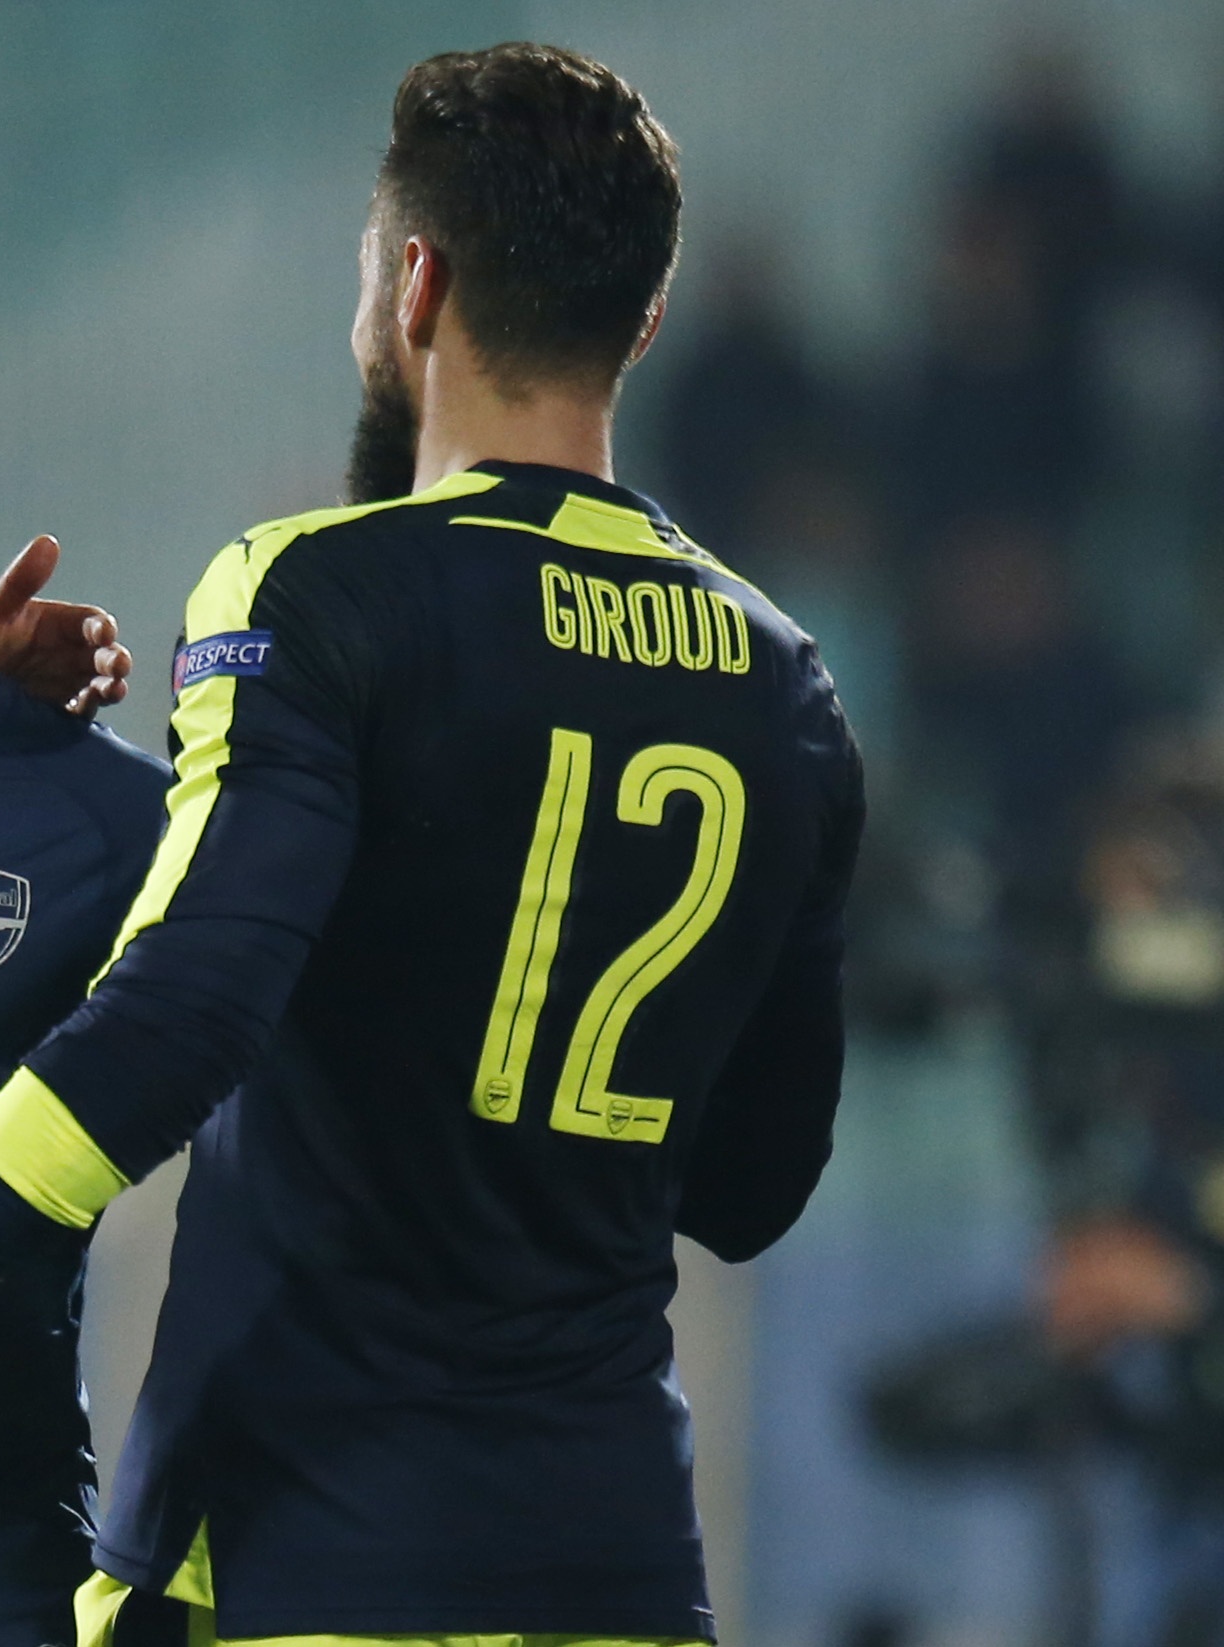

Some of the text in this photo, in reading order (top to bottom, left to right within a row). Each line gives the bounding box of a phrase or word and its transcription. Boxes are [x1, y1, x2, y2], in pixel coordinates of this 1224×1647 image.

[186, 643, 271, 675] RESPECT
[540, 562, 751, 675] GIROUD
[468, 727, 746, 1144] 12
